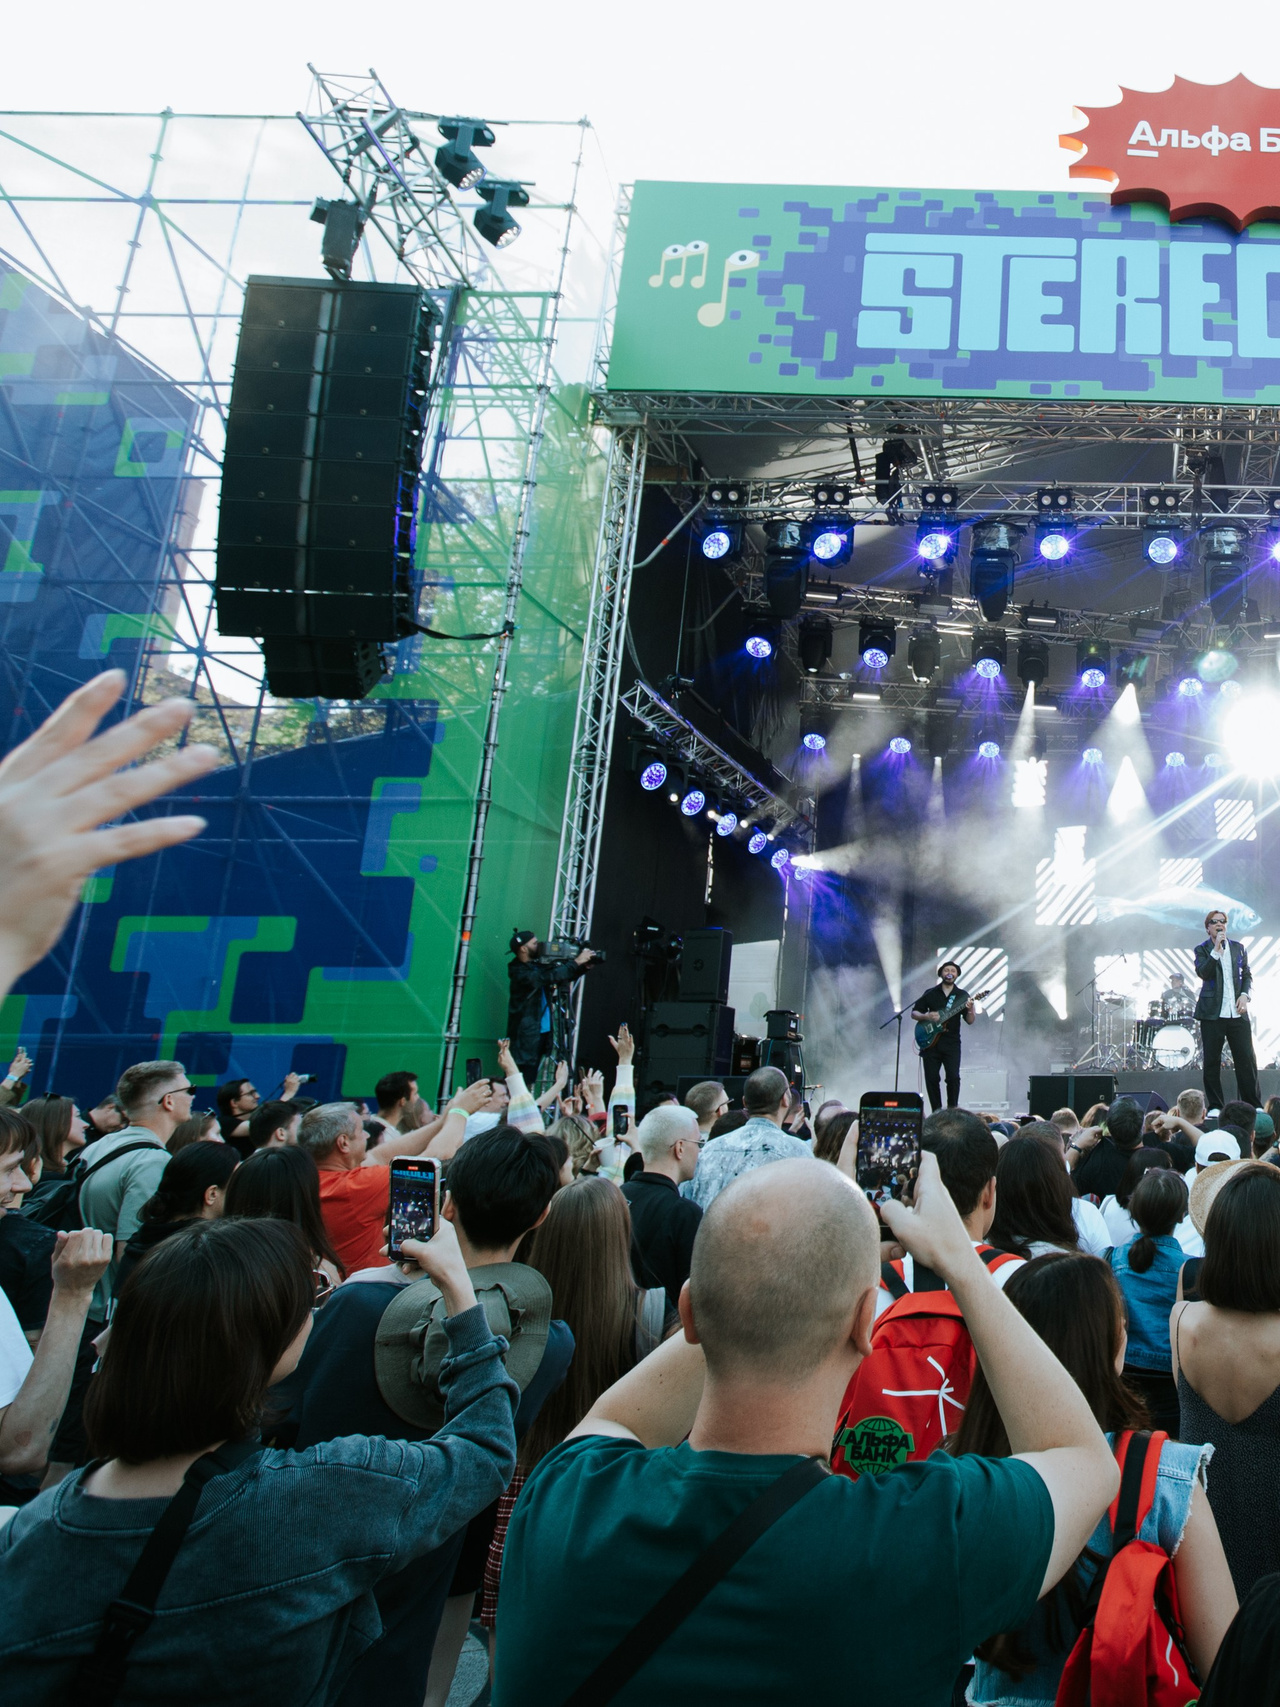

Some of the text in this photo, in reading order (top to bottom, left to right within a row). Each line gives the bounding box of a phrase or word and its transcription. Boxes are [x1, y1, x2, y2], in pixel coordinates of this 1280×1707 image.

[1127, 120, 1252, 157] Альфа
[845, 1430, 910, 1450] АЛЬФА
[850, 1445, 900, 1464] БАНК
